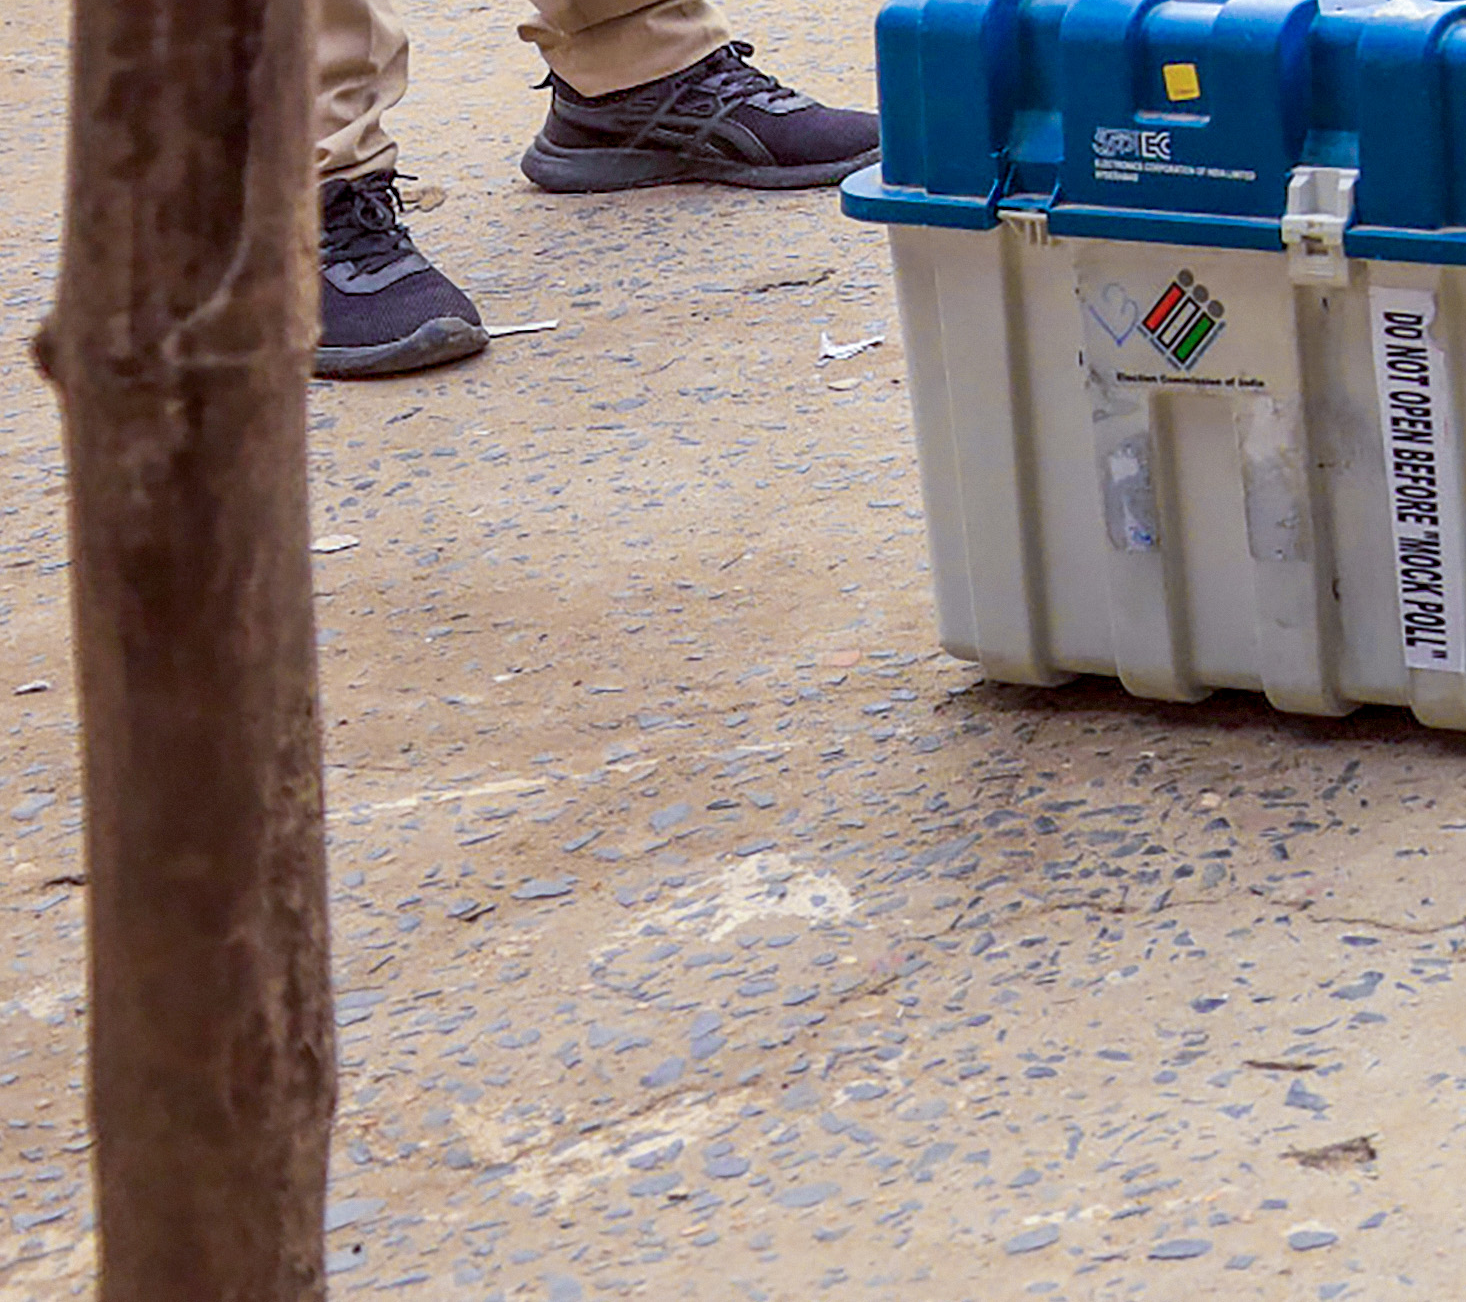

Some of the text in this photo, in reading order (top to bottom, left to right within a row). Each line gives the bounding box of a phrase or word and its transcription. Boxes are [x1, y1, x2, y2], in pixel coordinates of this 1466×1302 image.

[1383, 311, 1448, 659] DO NOT OPEN BEFORE "MOCK POLL"
